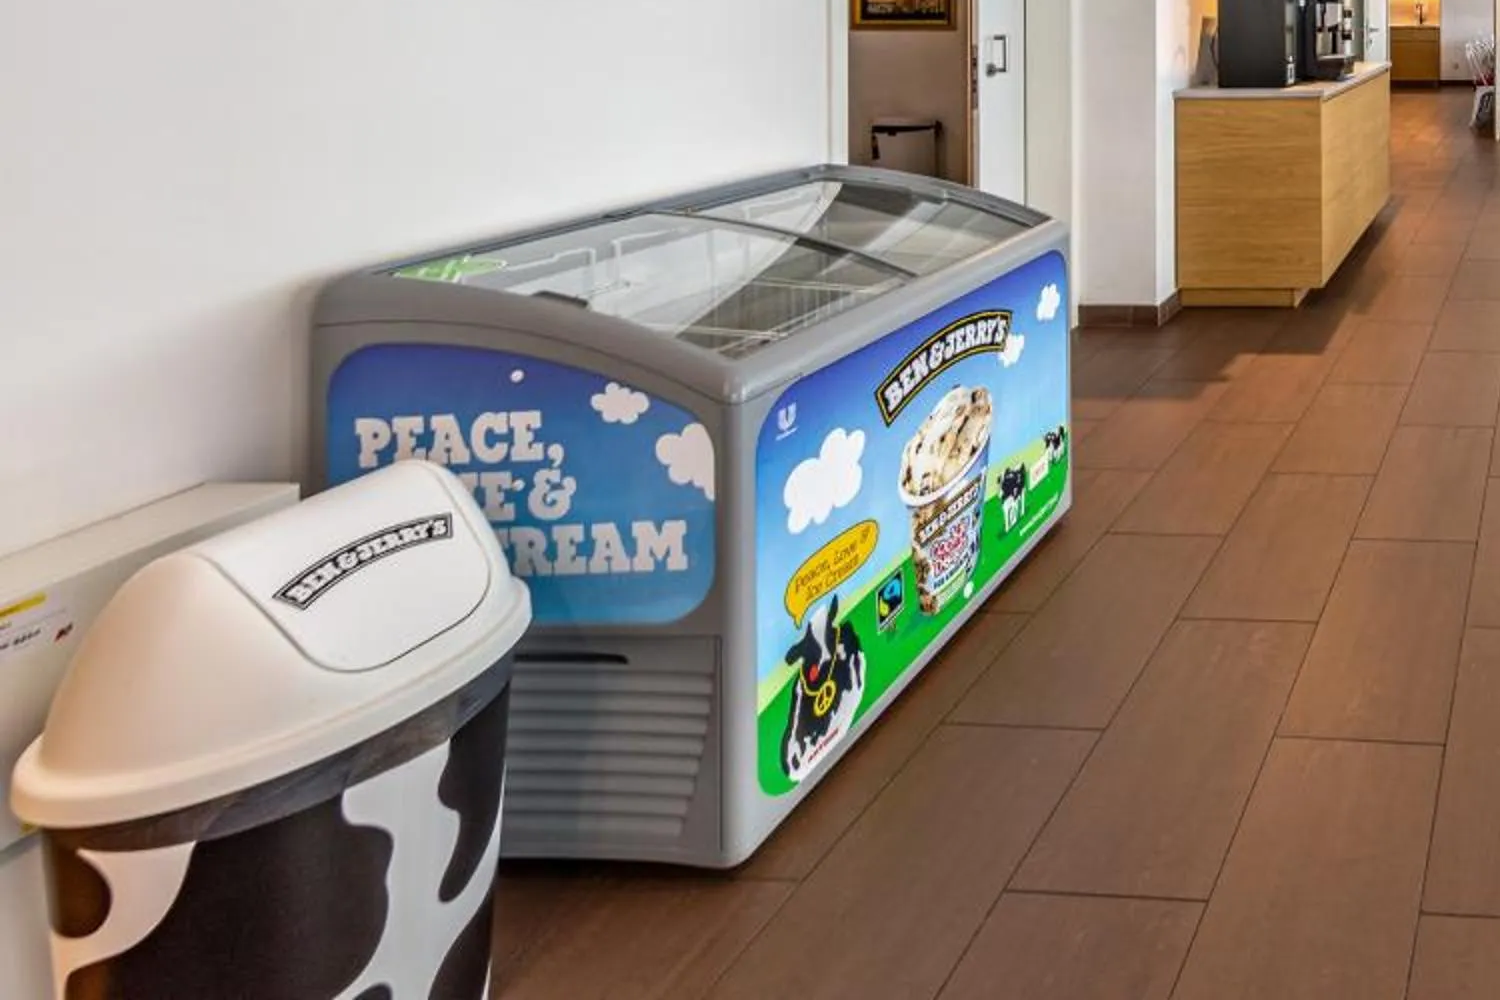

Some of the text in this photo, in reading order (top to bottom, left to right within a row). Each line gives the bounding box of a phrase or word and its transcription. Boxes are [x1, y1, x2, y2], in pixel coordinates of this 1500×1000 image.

[883, 350, 929, 412] BEN
[944, 317, 1008, 360] JERRY'S
[354, 410, 565, 468] PEACE,
[527, 469, 577, 520] &
[496, 520, 688, 577] REAM
